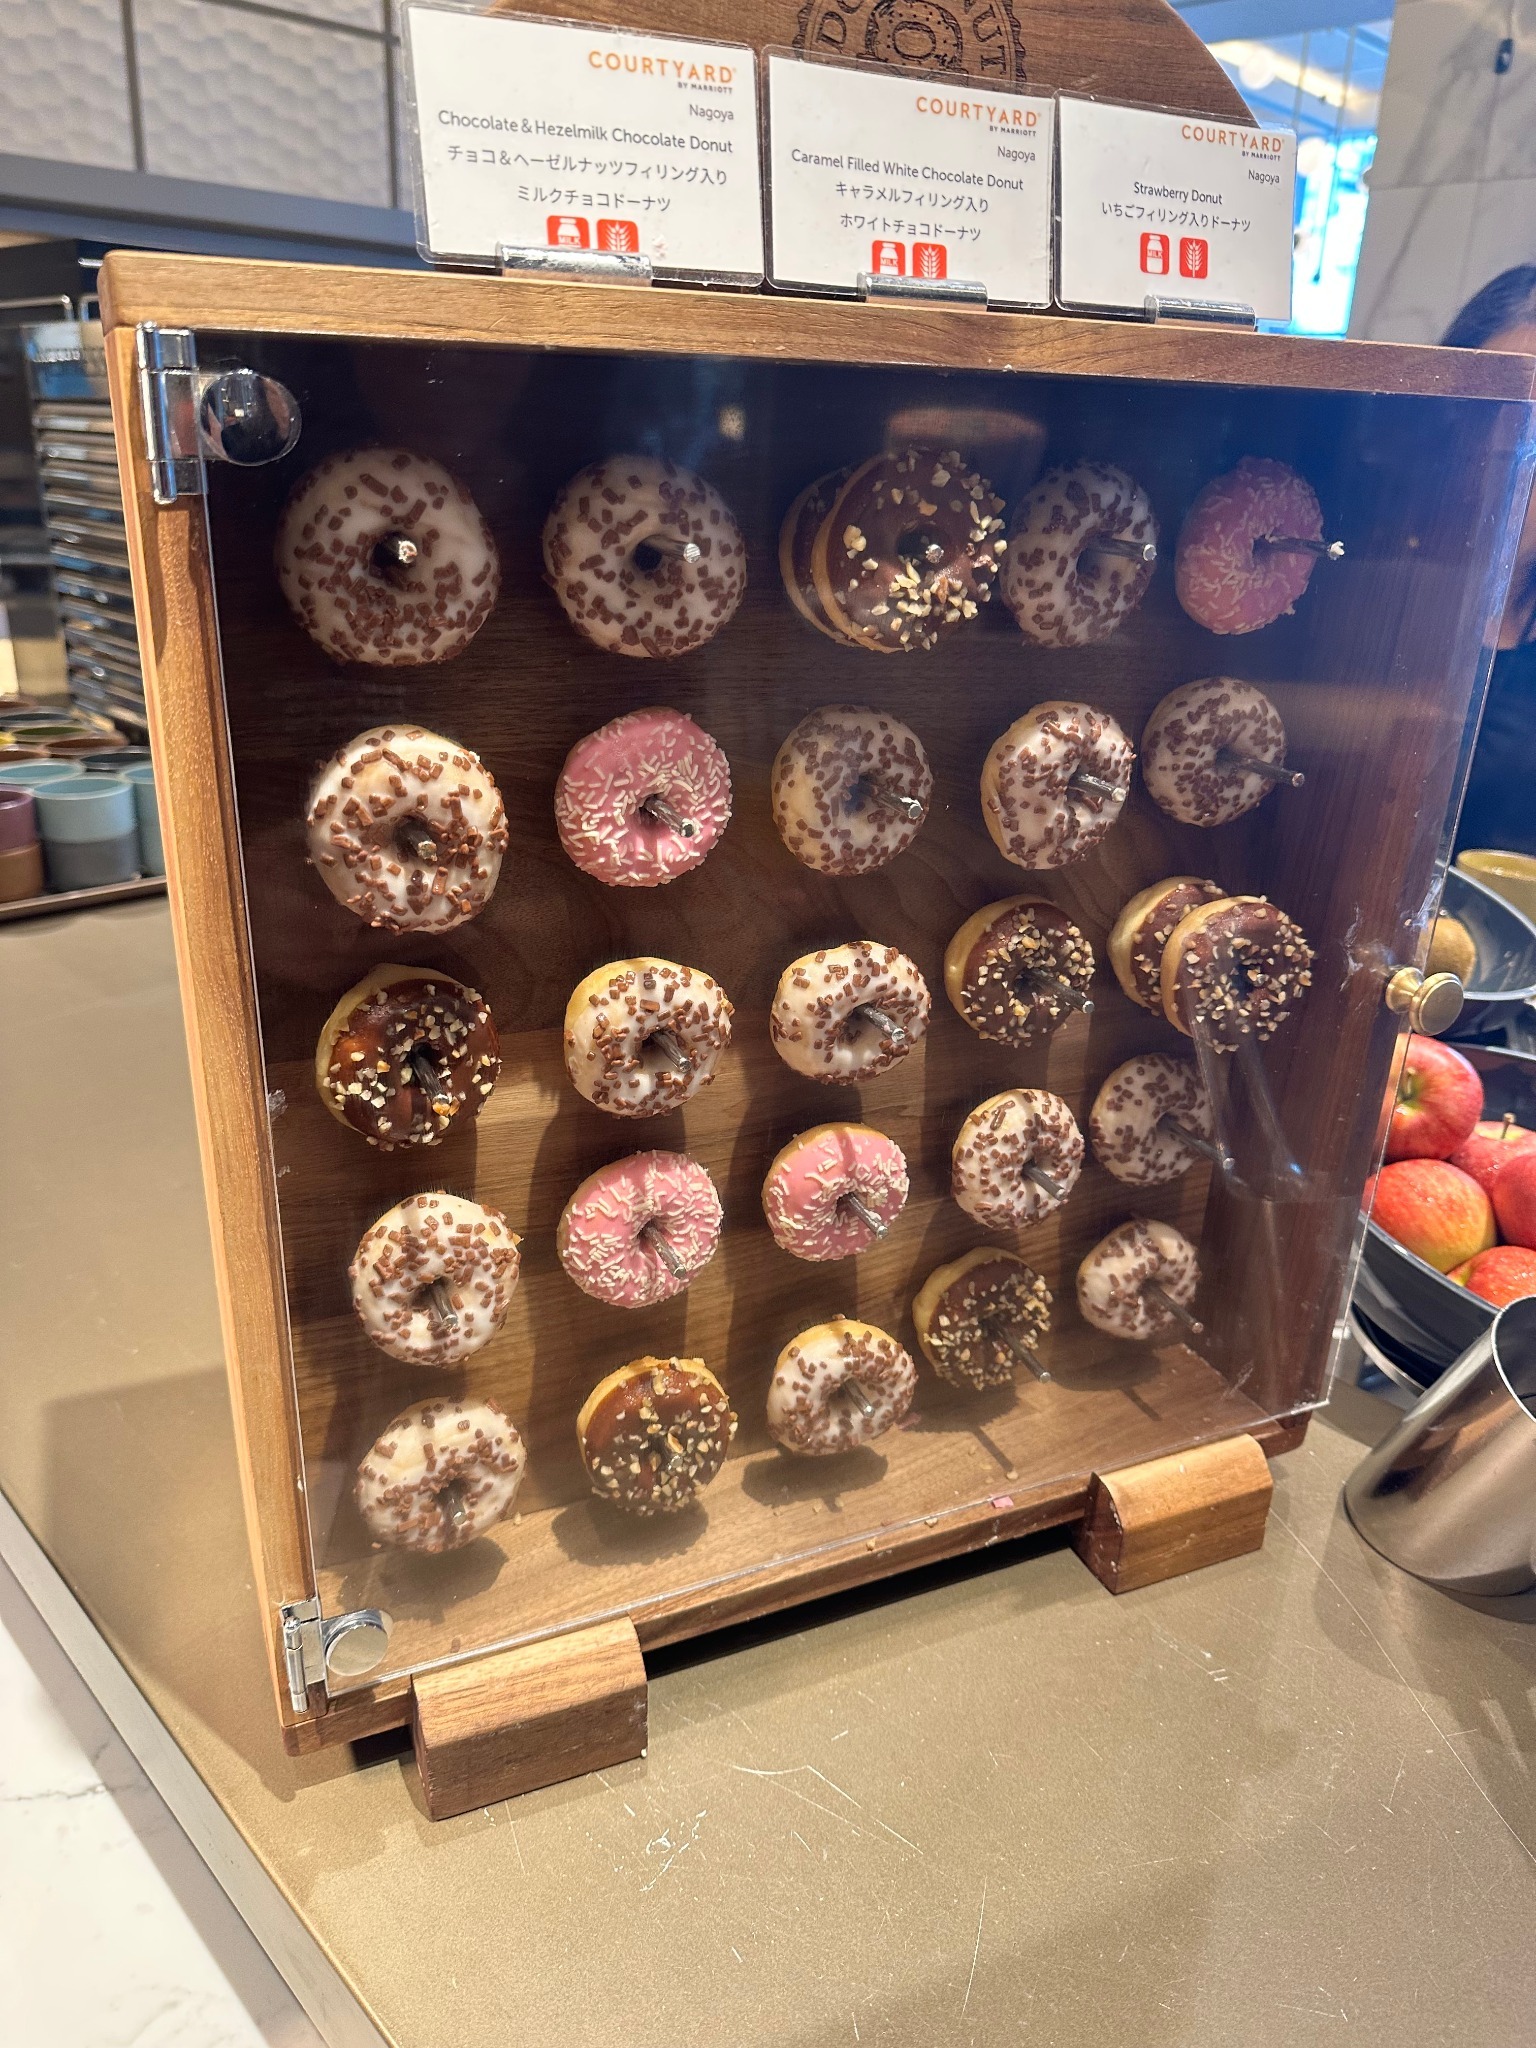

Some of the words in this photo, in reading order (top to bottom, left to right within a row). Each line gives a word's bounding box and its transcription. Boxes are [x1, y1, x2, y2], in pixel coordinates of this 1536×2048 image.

[588, 50, 733, 84] COURTYARD
[691, 83, 733, 95] MARRIOTT
[689, 103, 735, 123] Nagoya
[916, 96, 1038, 127] COURTYARD
[612, 127, 686, 149] Chocolate
[689, 135, 733, 154] Donut
[1001, 126, 1037, 137] MARRIOTT
[1181, 124, 1282, 152] COURTYARD
[997, 145, 1036, 164] Nagoya
[1250, 151, 1281, 161] MARRIOTT
[791, 148, 844, 169] Caramel
[847, 156, 880, 173] Filled
[883, 160, 919, 178] White
[922, 166, 984, 186] Chocolate
[987, 174, 1024, 191] Donut
[1248, 168, 1280, 186] Nagoya
[517, 185, 671, 212] ミルクチョコドーナツ
[835, 181, 989, 213] キャラメルフィリング入り
[1133, 181, 1189, 204] Strawberry
[1191, 189, 1223, 206] Donut
[840, 213, 981, 241] ホワイトチョコドーナツ
[1101, 201, 1251, 233] いちごフィリング入りドーナツ
[559, 235, 581, 246] MILK
[880, 257, 898, 267] MILK
[1146, 249, 1163, 259] MILK
